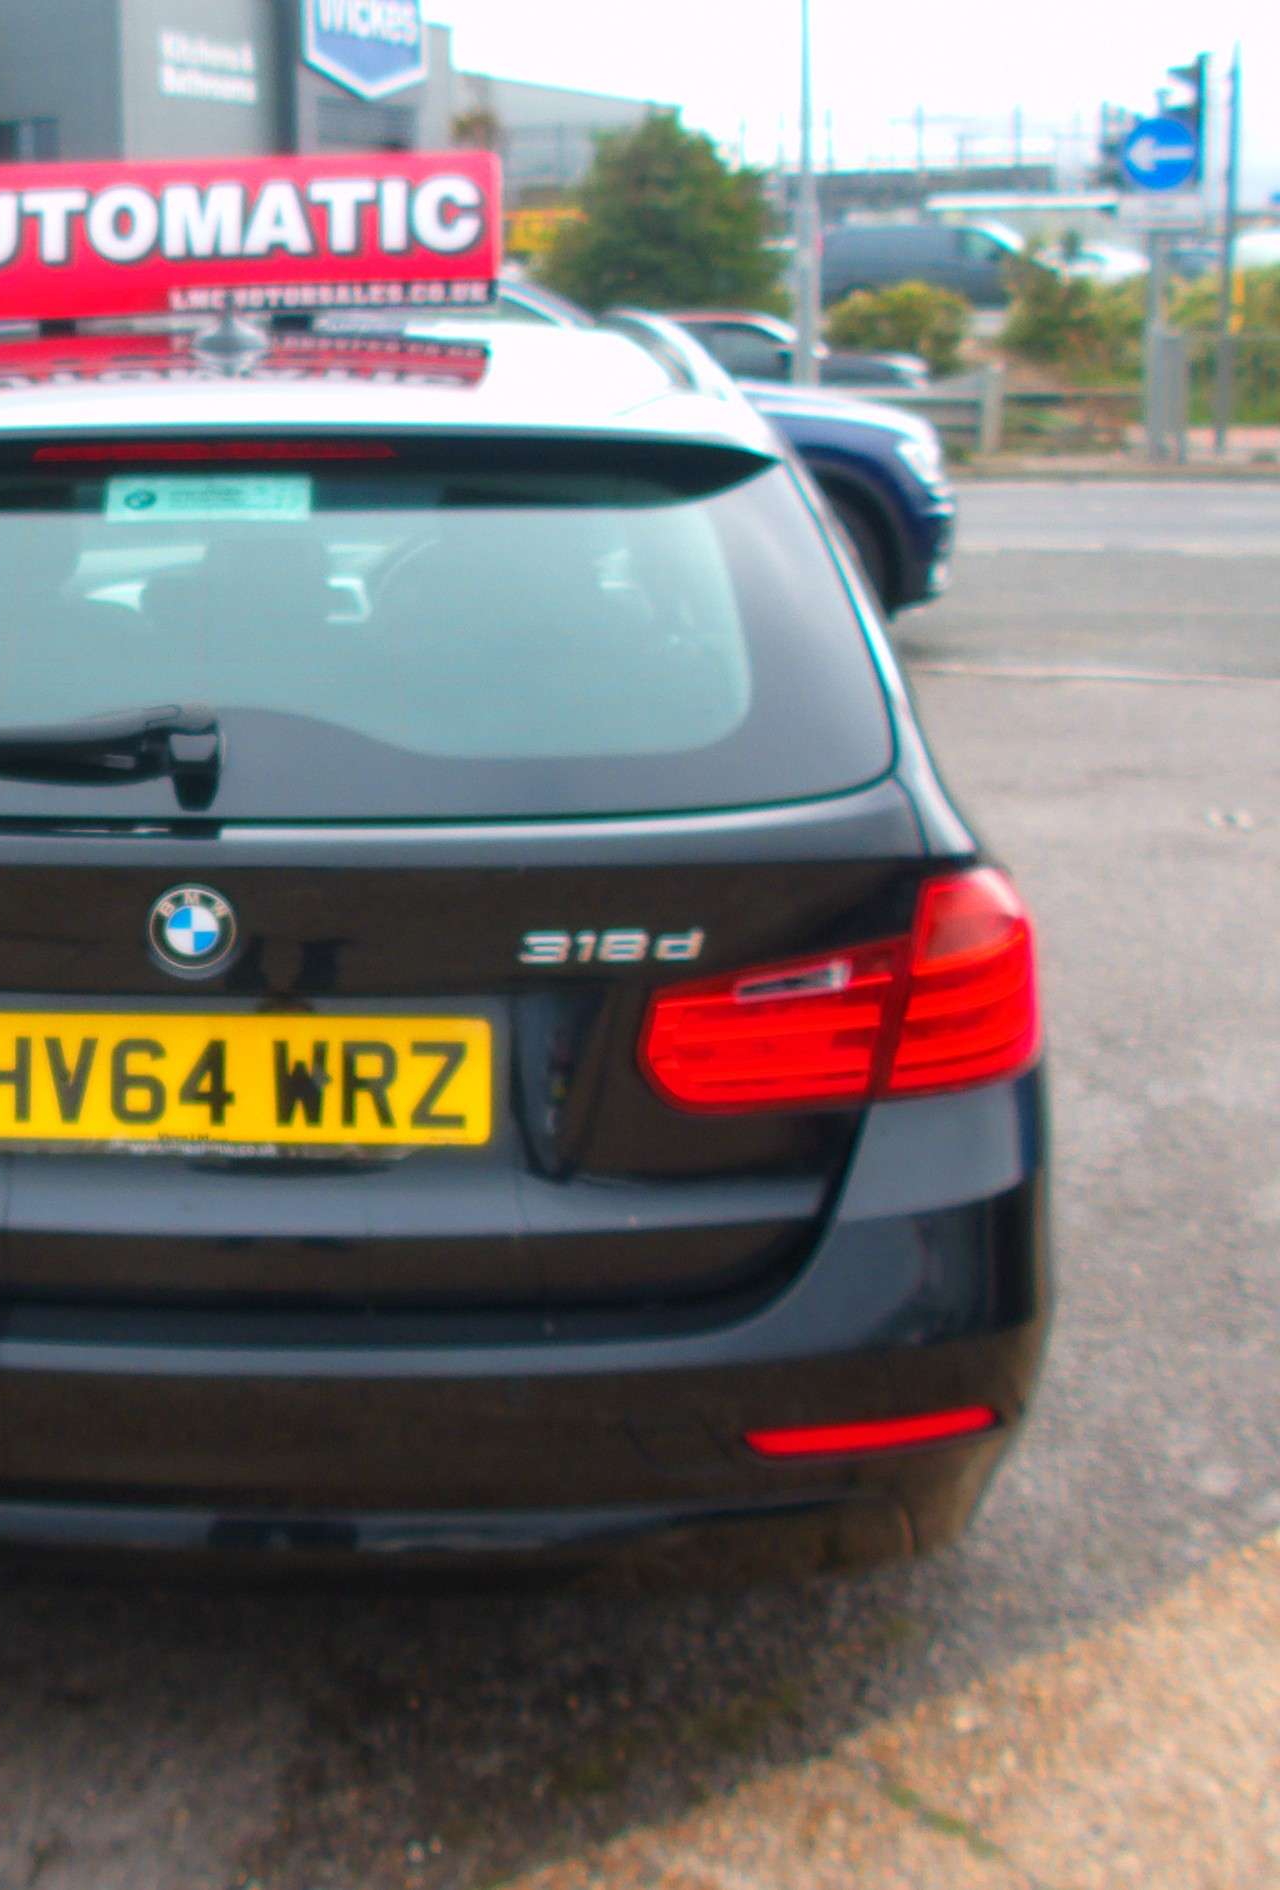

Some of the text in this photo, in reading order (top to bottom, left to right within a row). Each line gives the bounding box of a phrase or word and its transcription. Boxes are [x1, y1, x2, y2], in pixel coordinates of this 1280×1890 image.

[158, 888, 231, 918] BMW
[519, 928, 704, 963] 318d
[273, 1039, 467, 1128] WRZ
